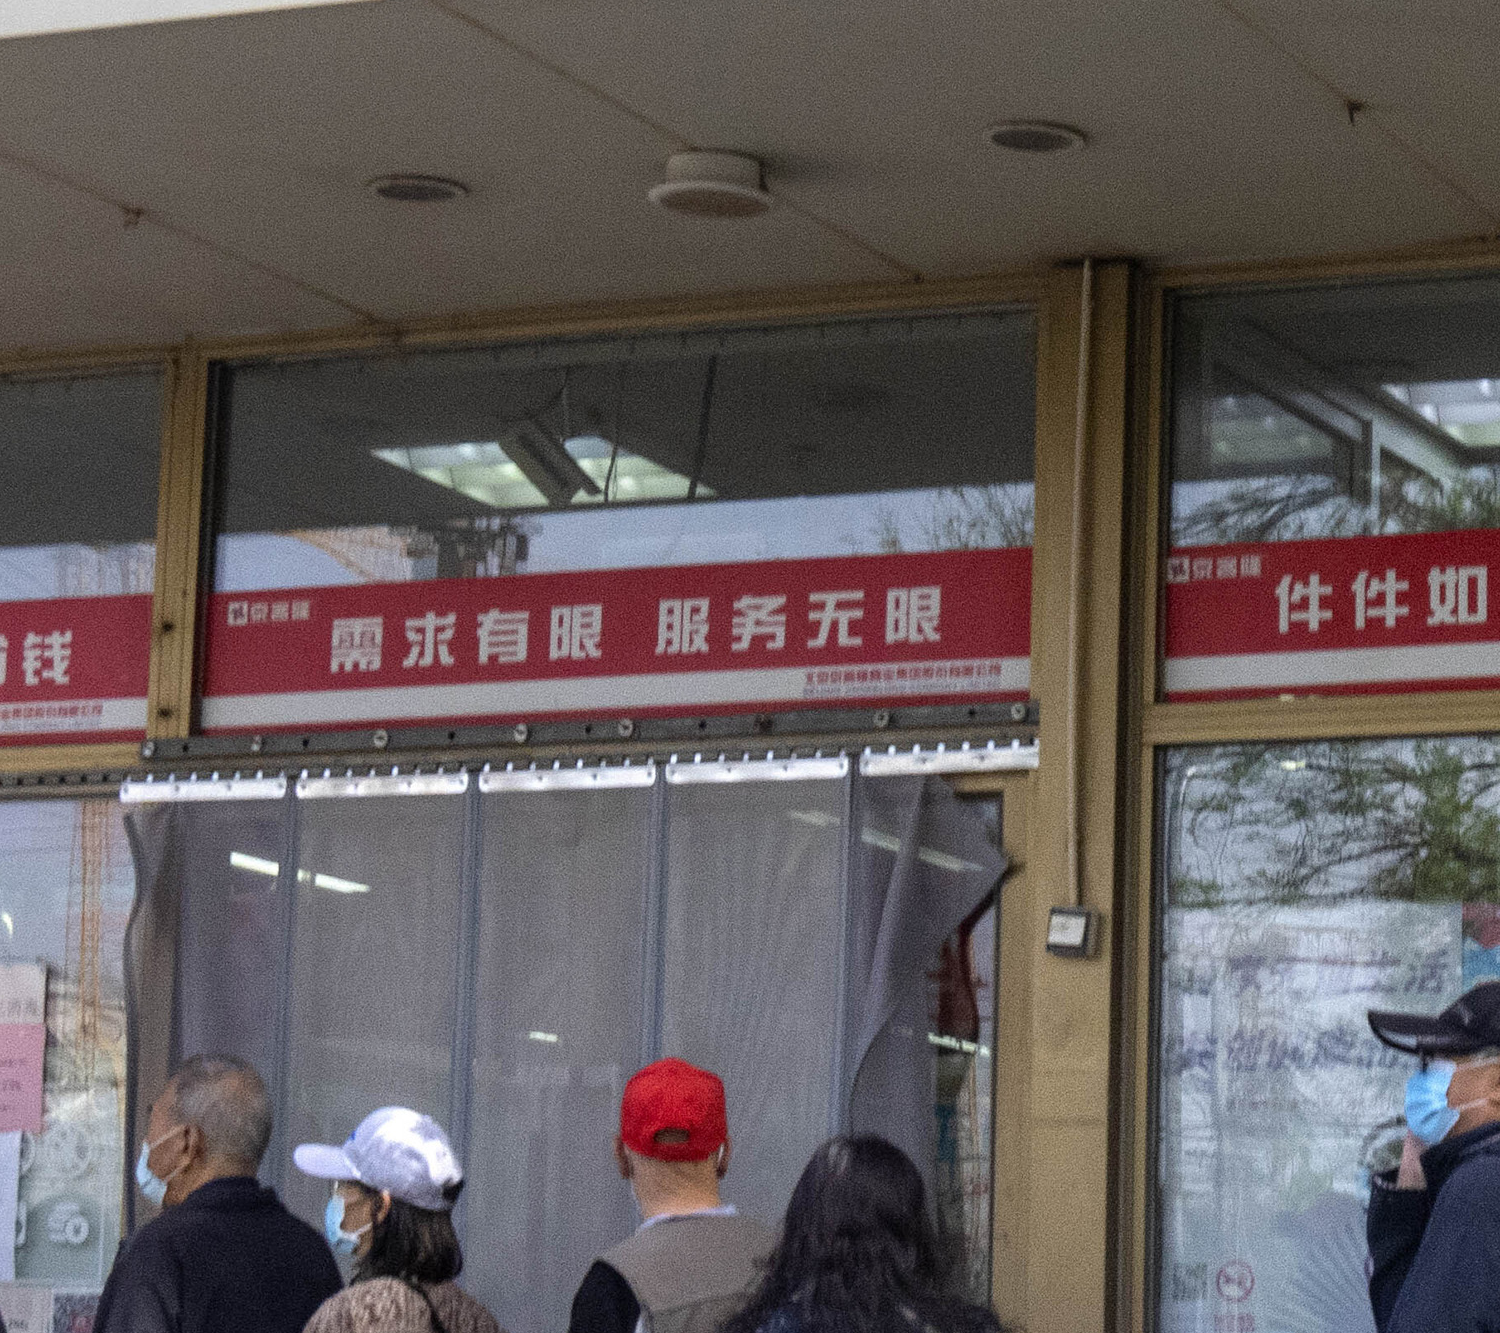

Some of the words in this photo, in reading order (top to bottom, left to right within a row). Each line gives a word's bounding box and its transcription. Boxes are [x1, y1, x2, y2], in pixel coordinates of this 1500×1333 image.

[330, 603, 603, 674] 需求有限
[655, 586, 942, 657] 服务无限
